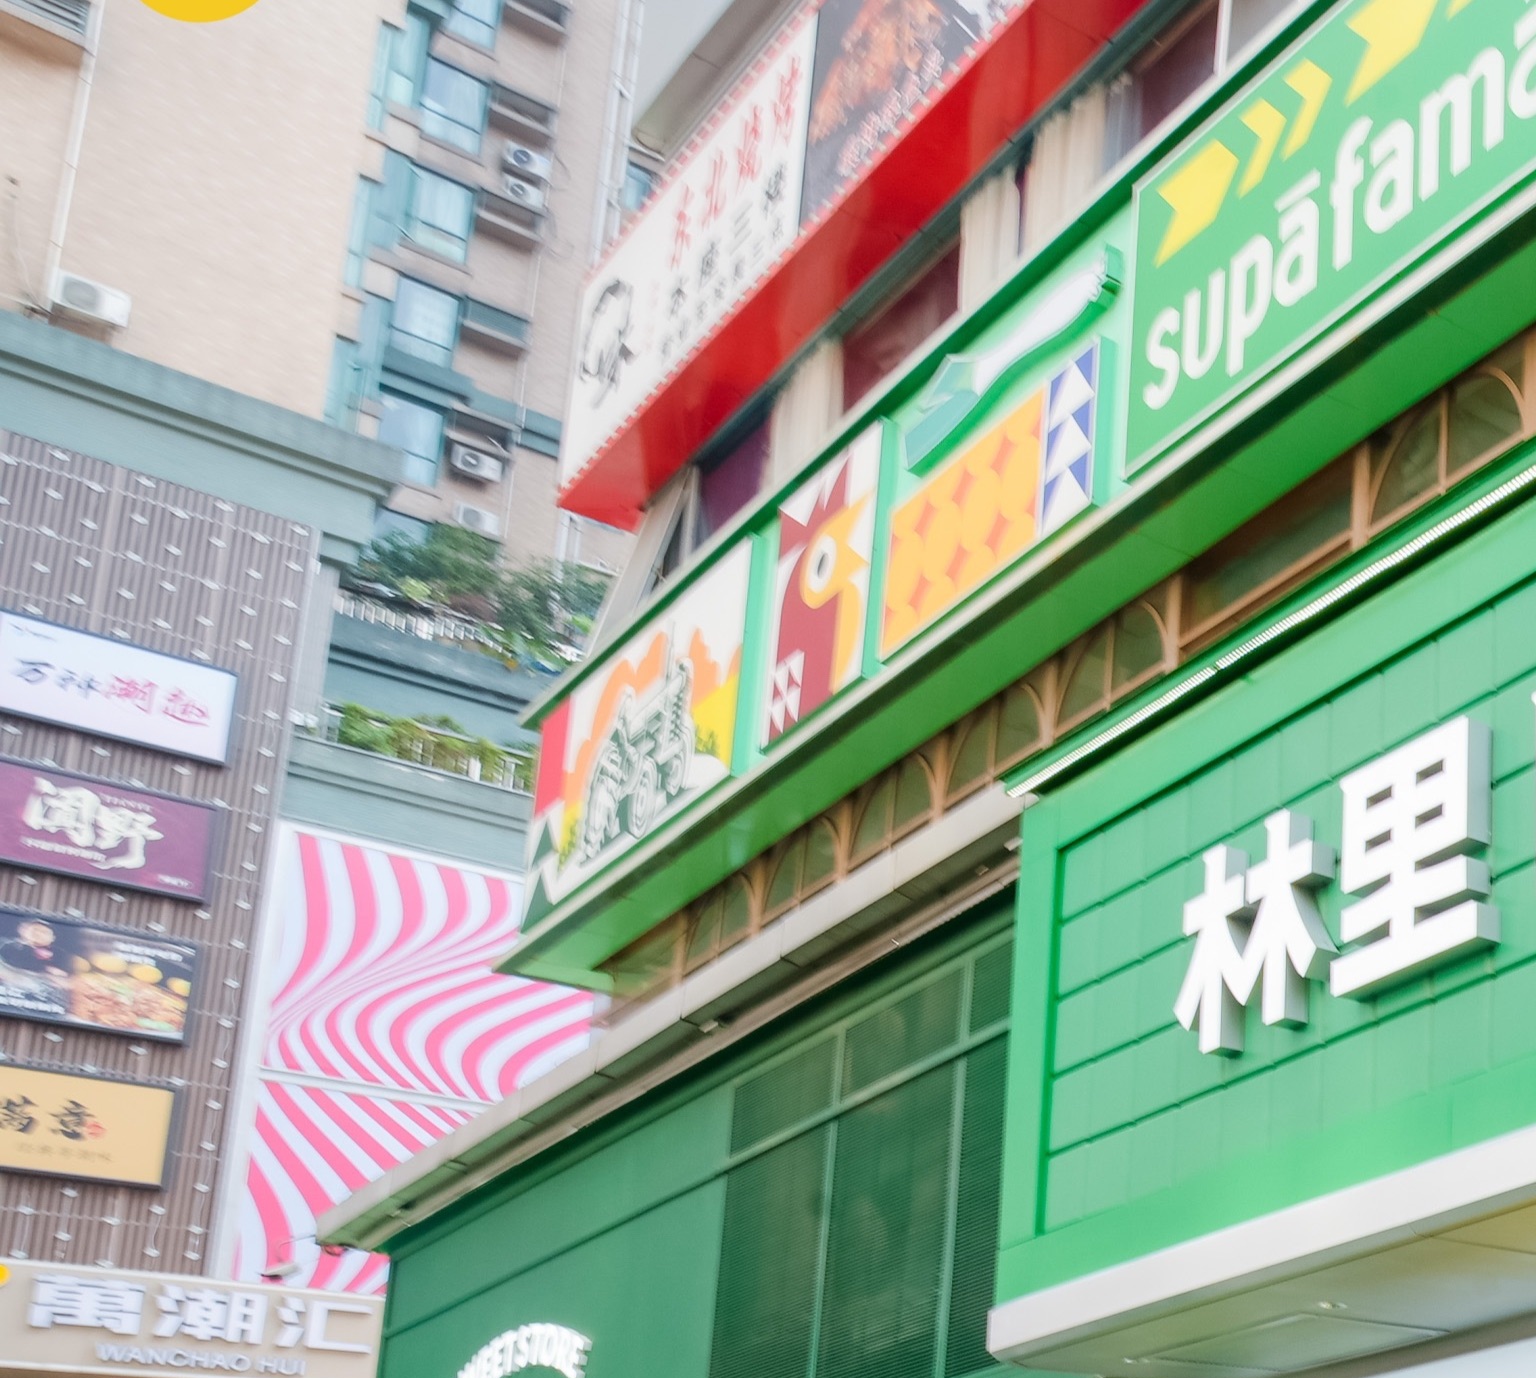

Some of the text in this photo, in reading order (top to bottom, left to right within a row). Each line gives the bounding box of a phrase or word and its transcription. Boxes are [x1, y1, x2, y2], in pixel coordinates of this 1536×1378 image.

[1173, 714, 1499, 1056] 林里
[94, 1342, 307, 1378] WANCHAO HUI
